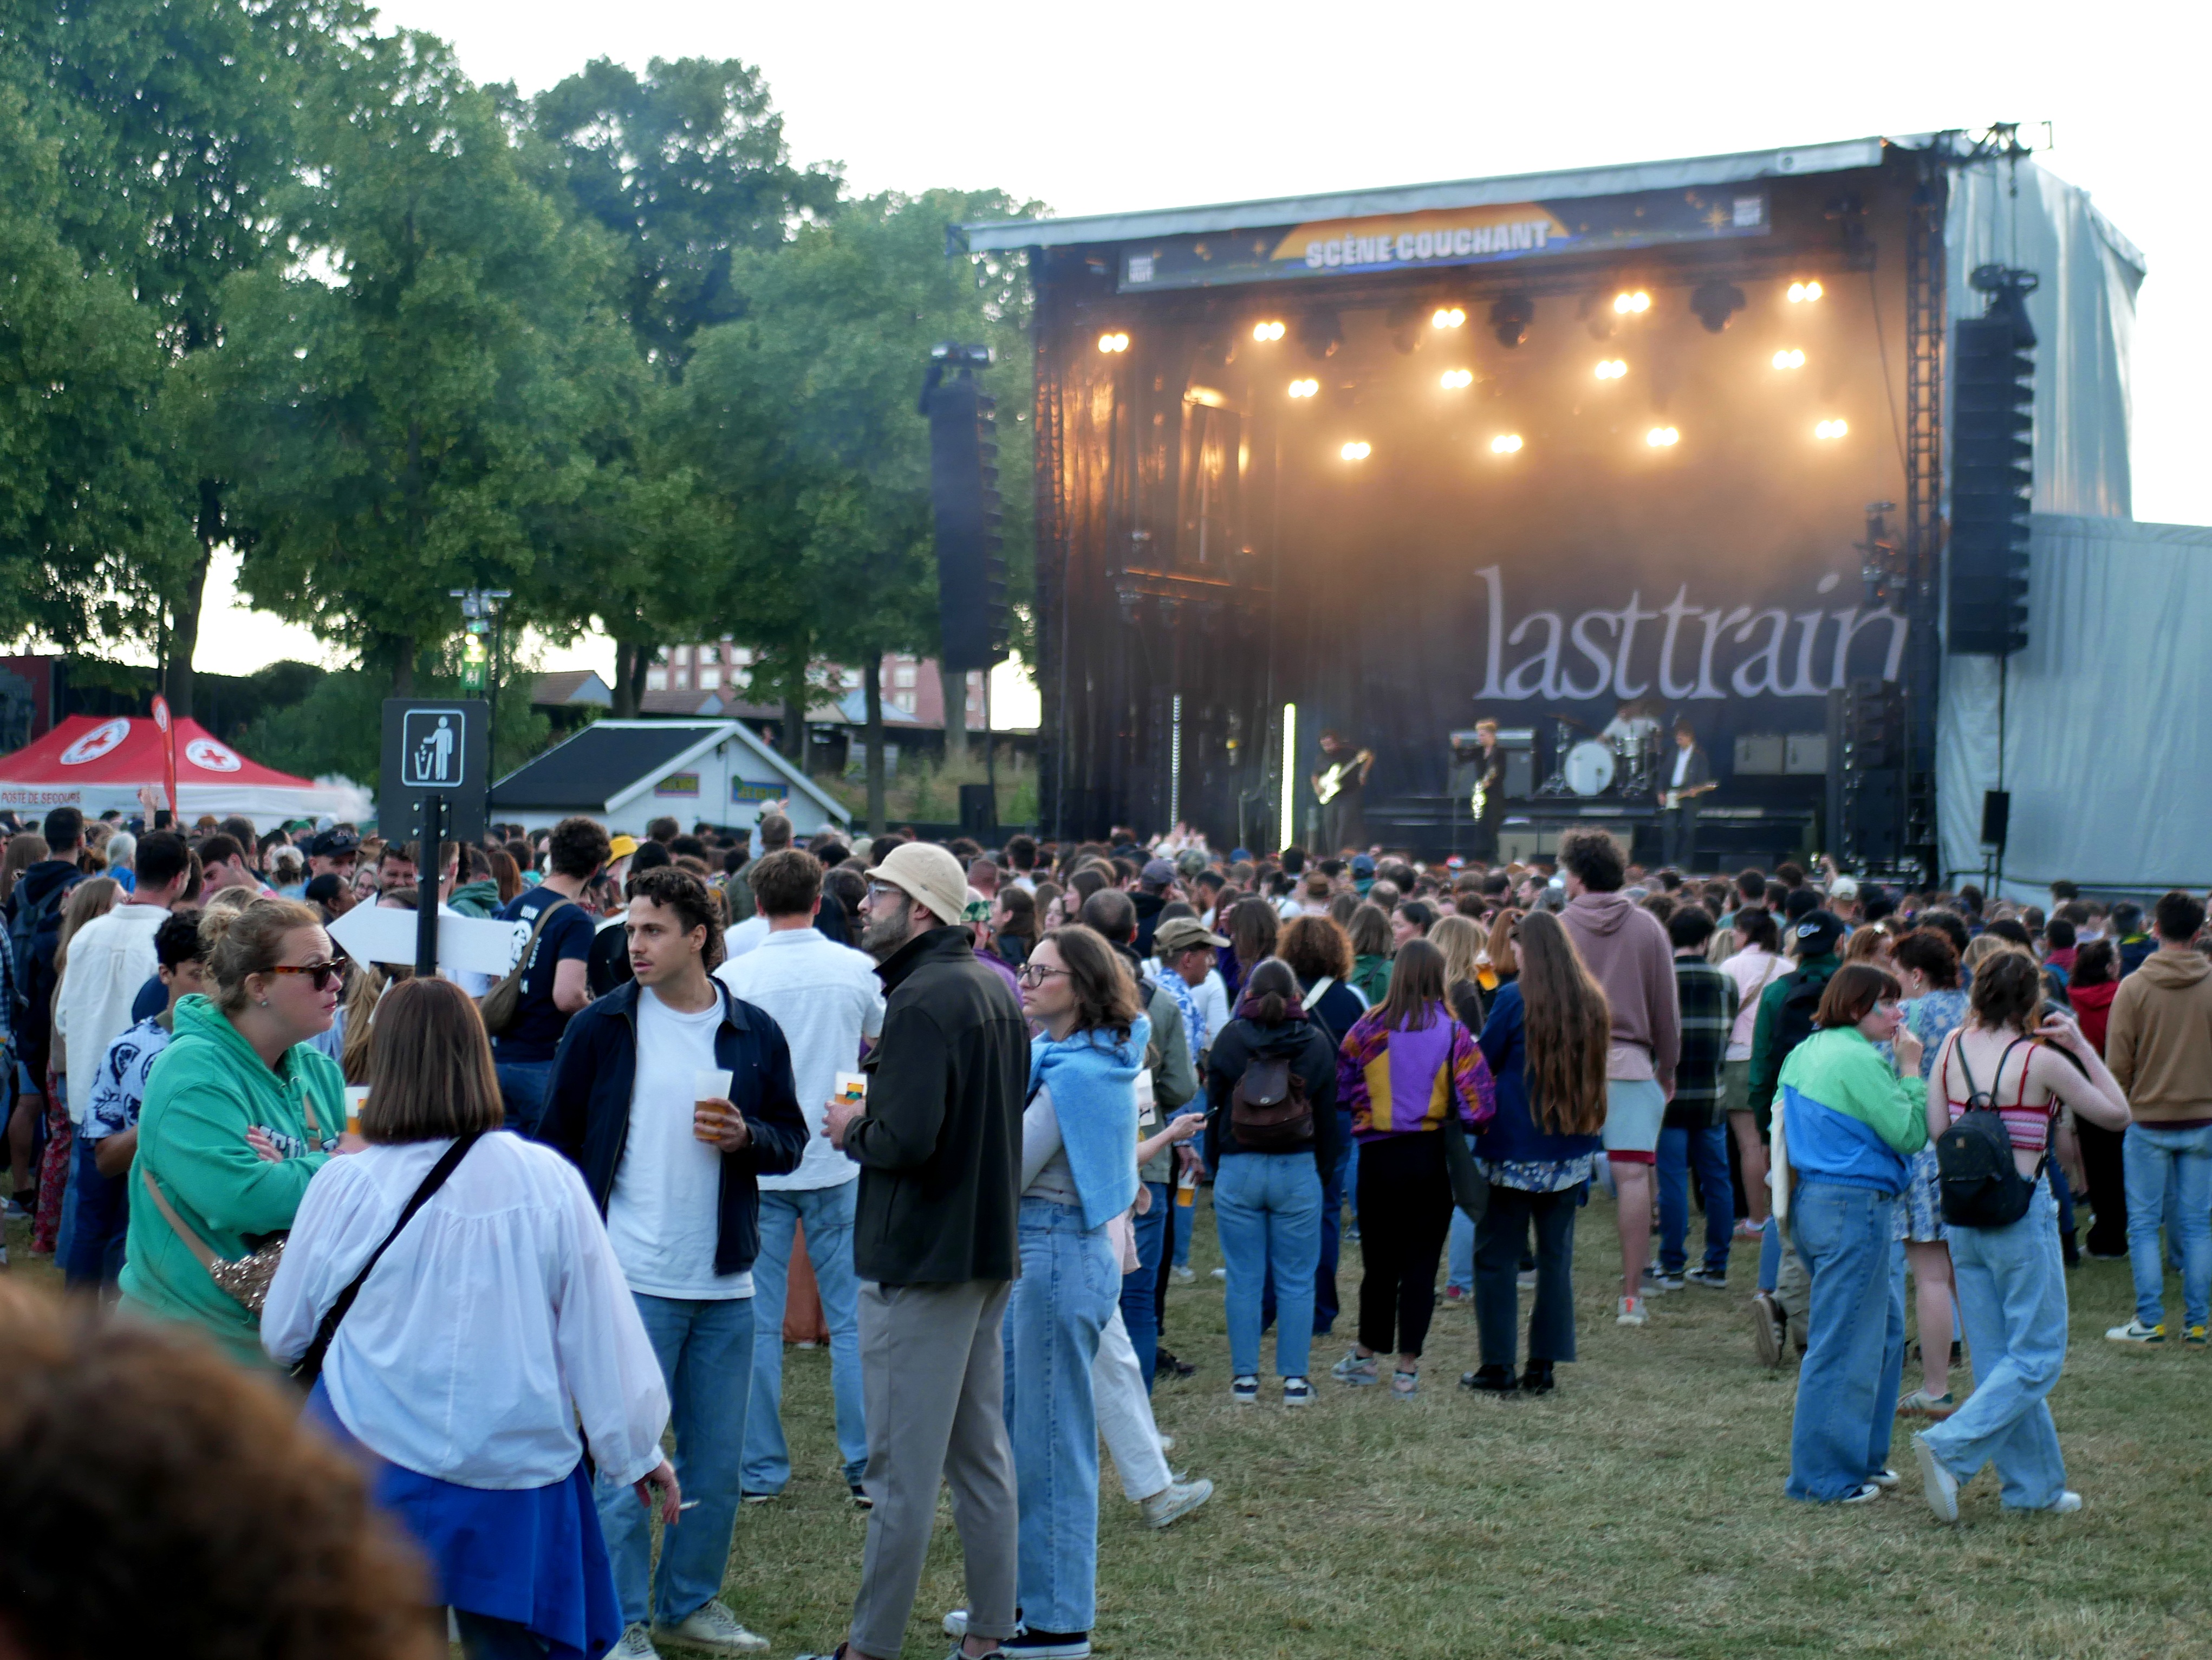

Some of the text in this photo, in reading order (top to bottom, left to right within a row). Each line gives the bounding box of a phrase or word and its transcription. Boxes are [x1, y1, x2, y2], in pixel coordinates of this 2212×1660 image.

[1305, 220, 1551, 269] SCÈNE COUCHANT
[2, 791, 27, 804] POSTE
[28, 792, 39, 804] DE
